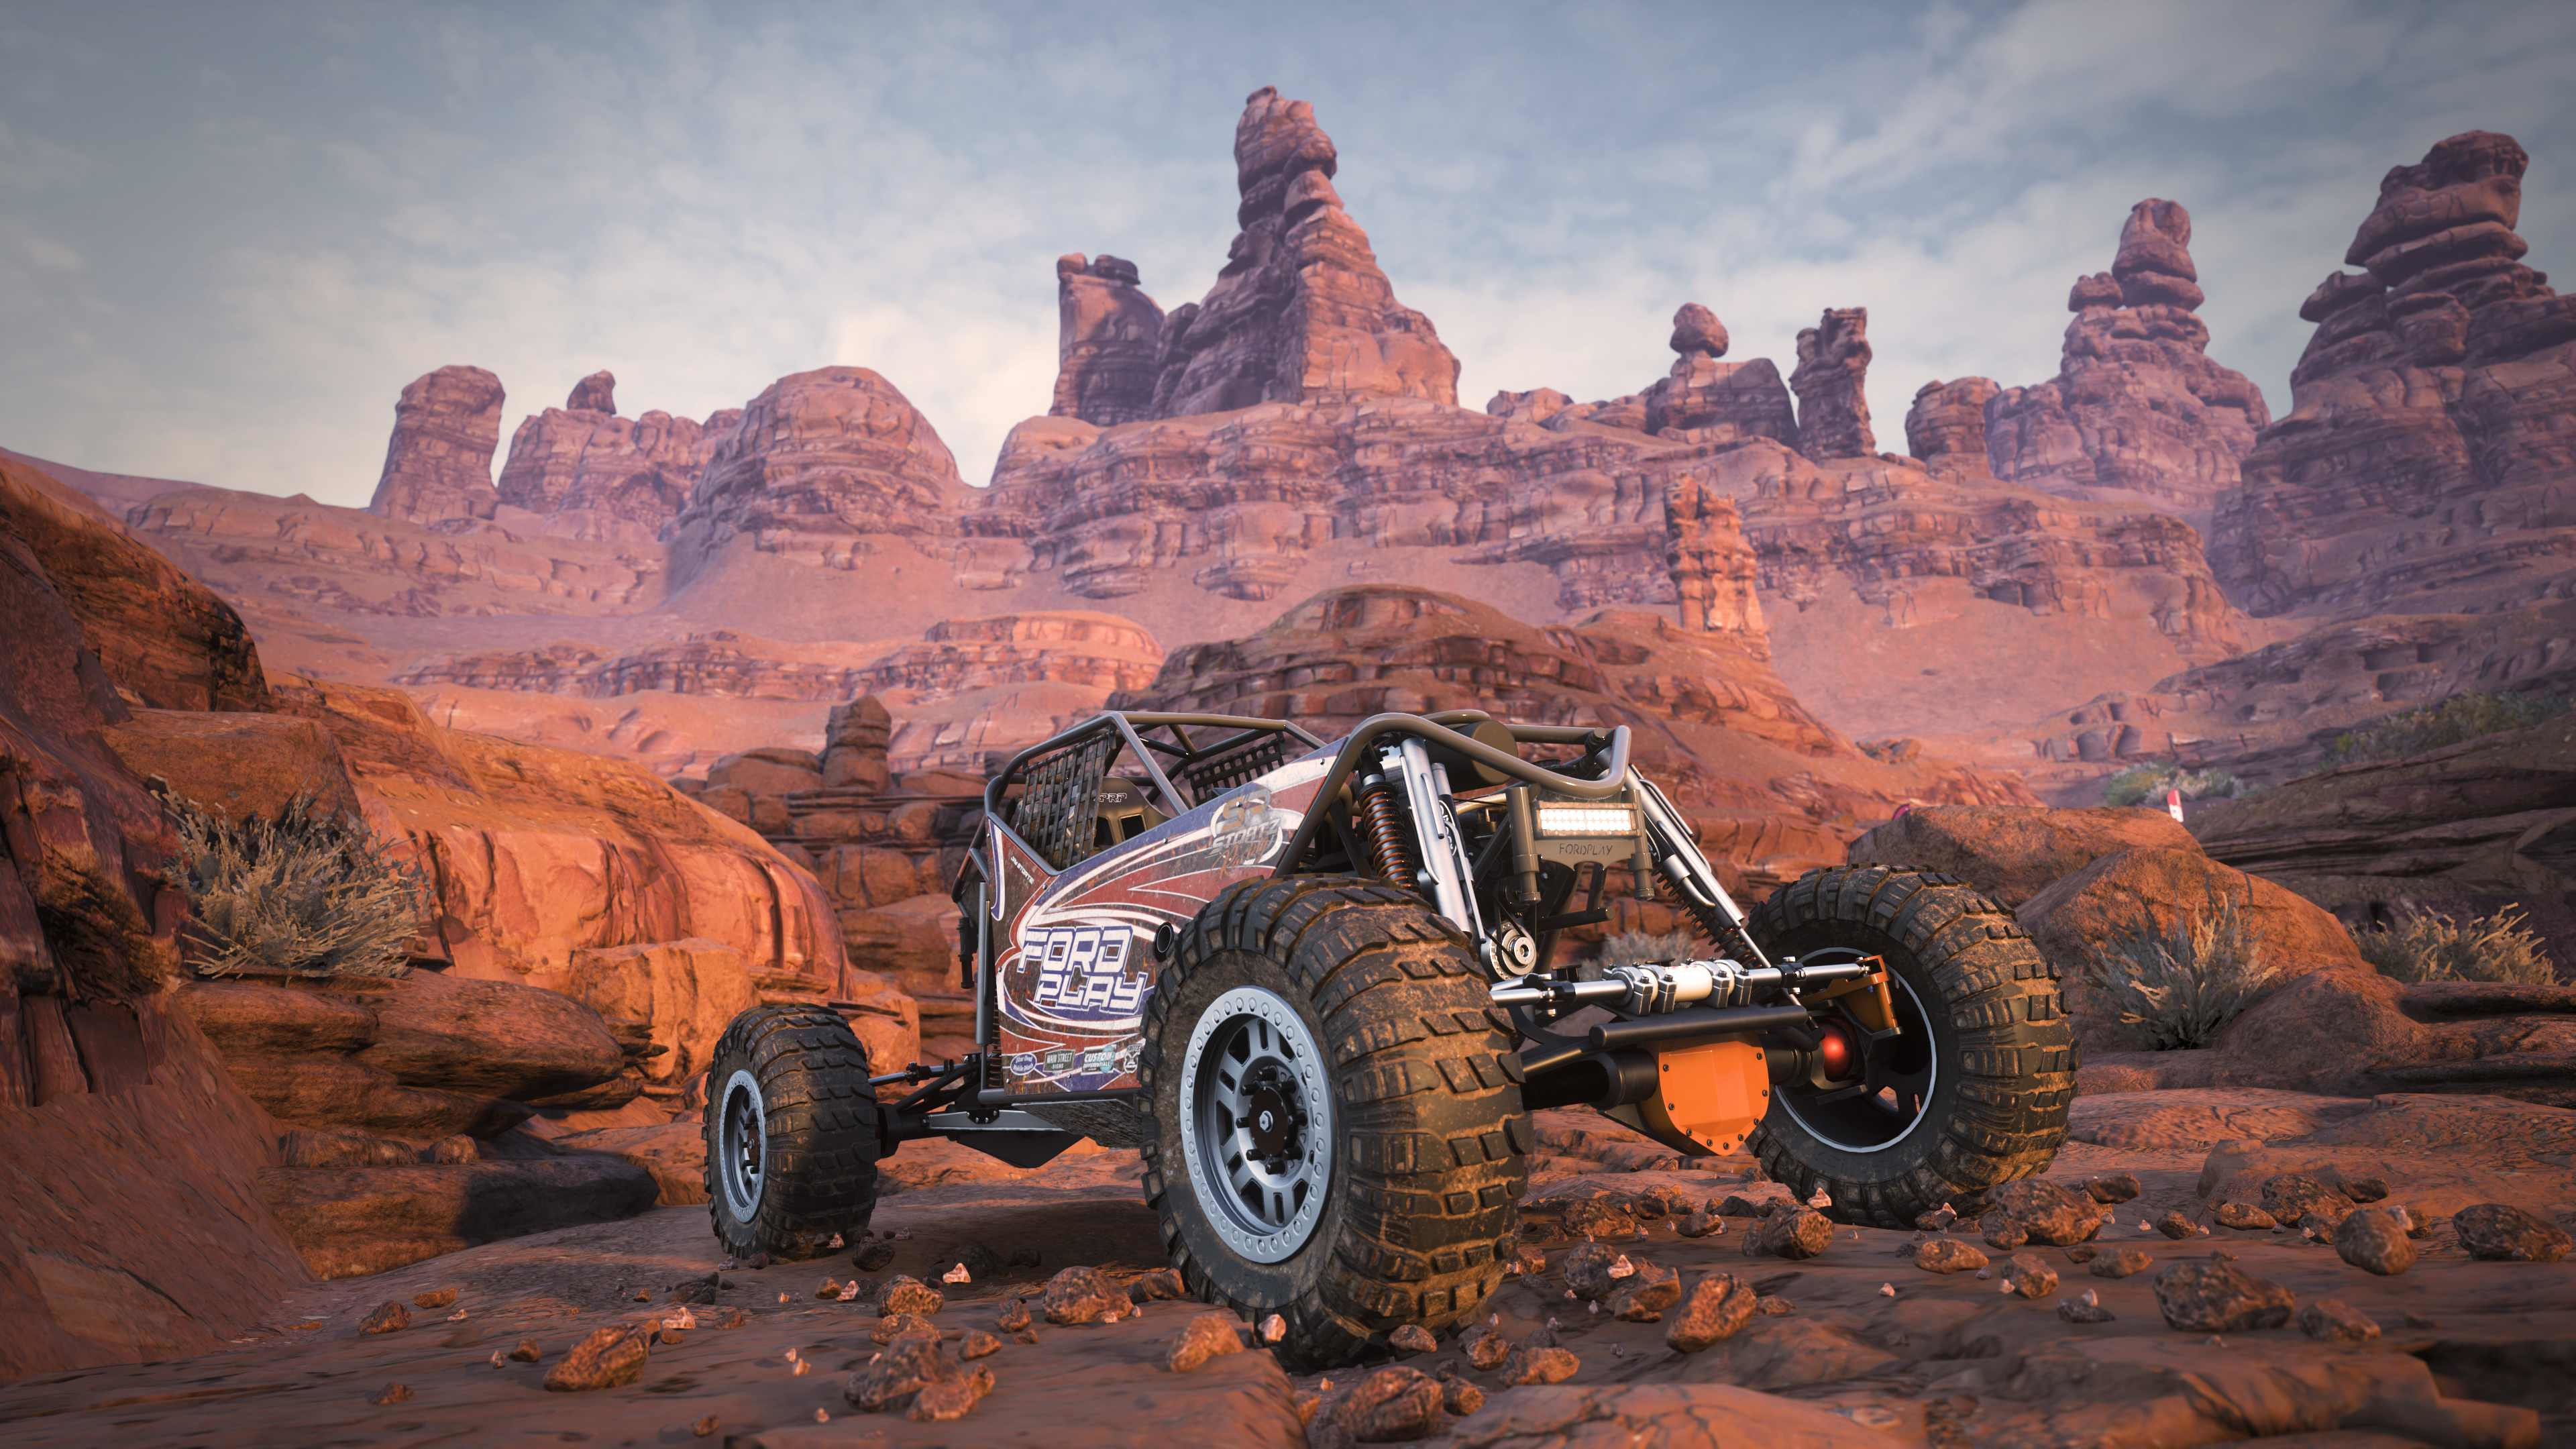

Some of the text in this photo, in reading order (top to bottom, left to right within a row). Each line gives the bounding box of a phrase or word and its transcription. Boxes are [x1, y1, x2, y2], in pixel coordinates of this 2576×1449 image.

[1099, 792, 1128, 803] PRP
[1558, 843, 1613, 855] FORDPLAY
[1017, 926, 1132, 973] FORD
[1034, 972, 1147, 1014] PLAY
[1046, 1053, 1073, 1063] MAIN STREET
[1084, 1051, 1112, 1063] CUSTOM
